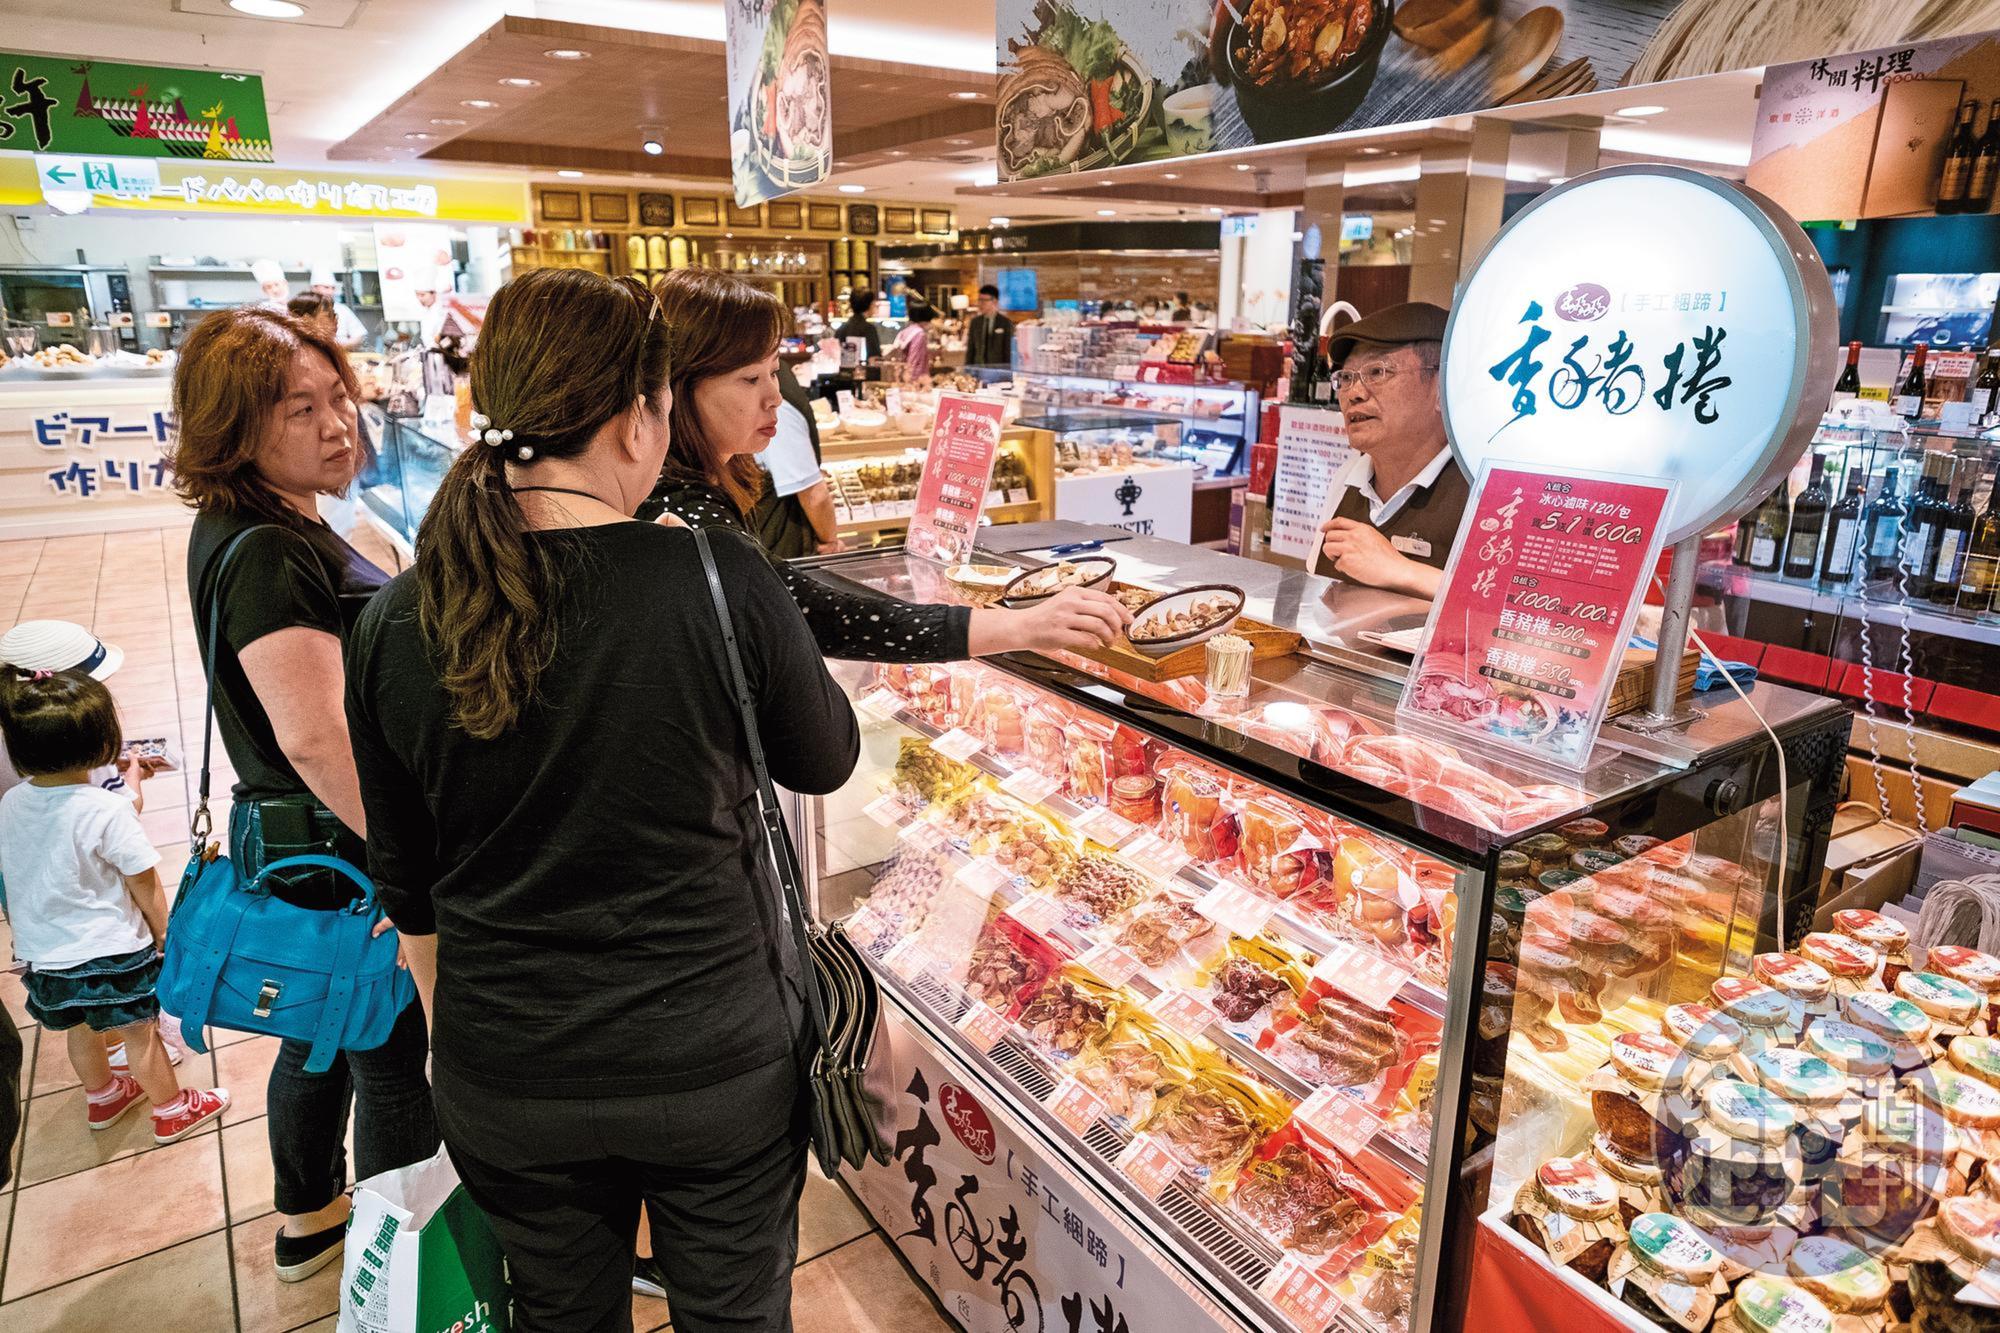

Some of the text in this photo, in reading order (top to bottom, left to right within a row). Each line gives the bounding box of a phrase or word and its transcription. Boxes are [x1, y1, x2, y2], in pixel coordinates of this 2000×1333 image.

[1810, 49, 1916, 94] 休閒料理
[0, 67, 59, 150] 午
[1488, 301, 1732, 443] 香豬捲
[1500, 607, 1551, 635] 香豬捲
[1485, 646, 1538, 675] 香豬捲
